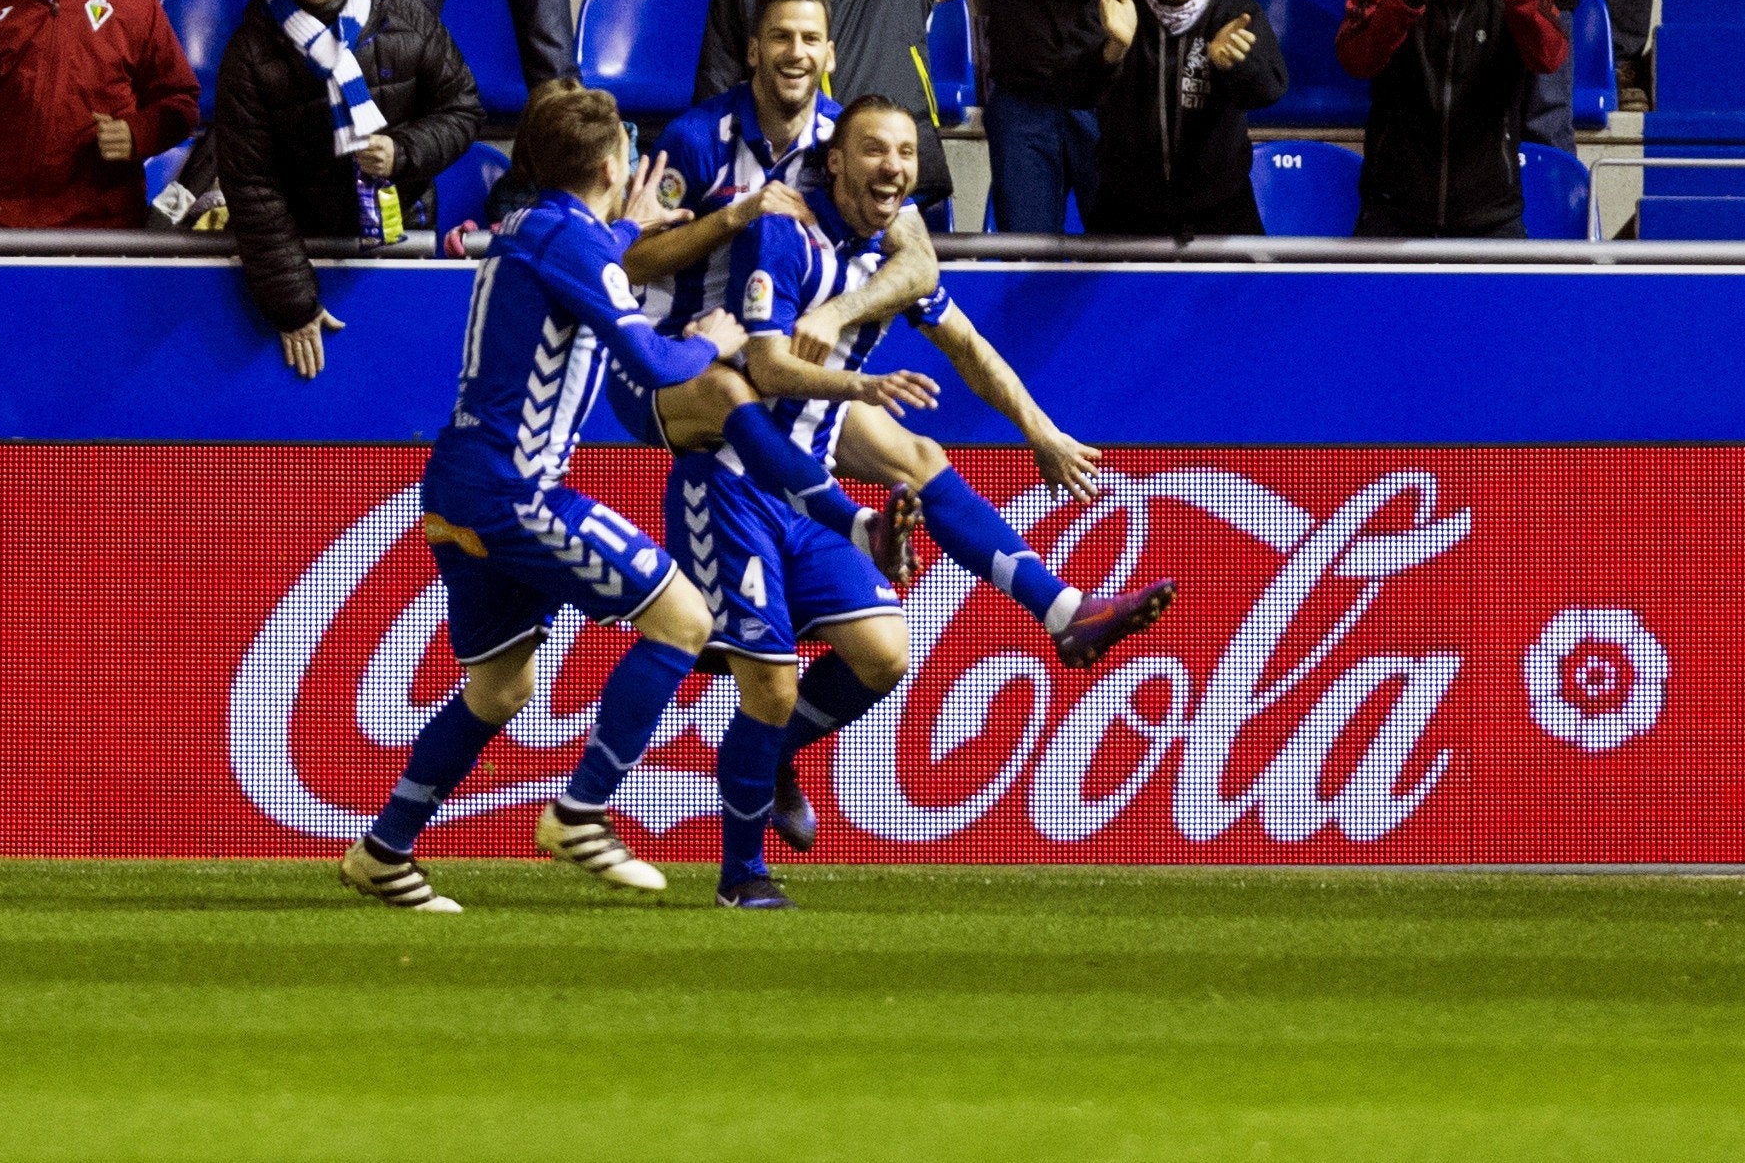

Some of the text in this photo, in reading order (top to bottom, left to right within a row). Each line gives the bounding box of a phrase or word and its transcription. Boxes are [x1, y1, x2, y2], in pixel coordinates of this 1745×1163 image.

[1271, 154, 1303, 169] 101
[579, 504, 640, 553] 11
[739, 556, 768, 609] 4
